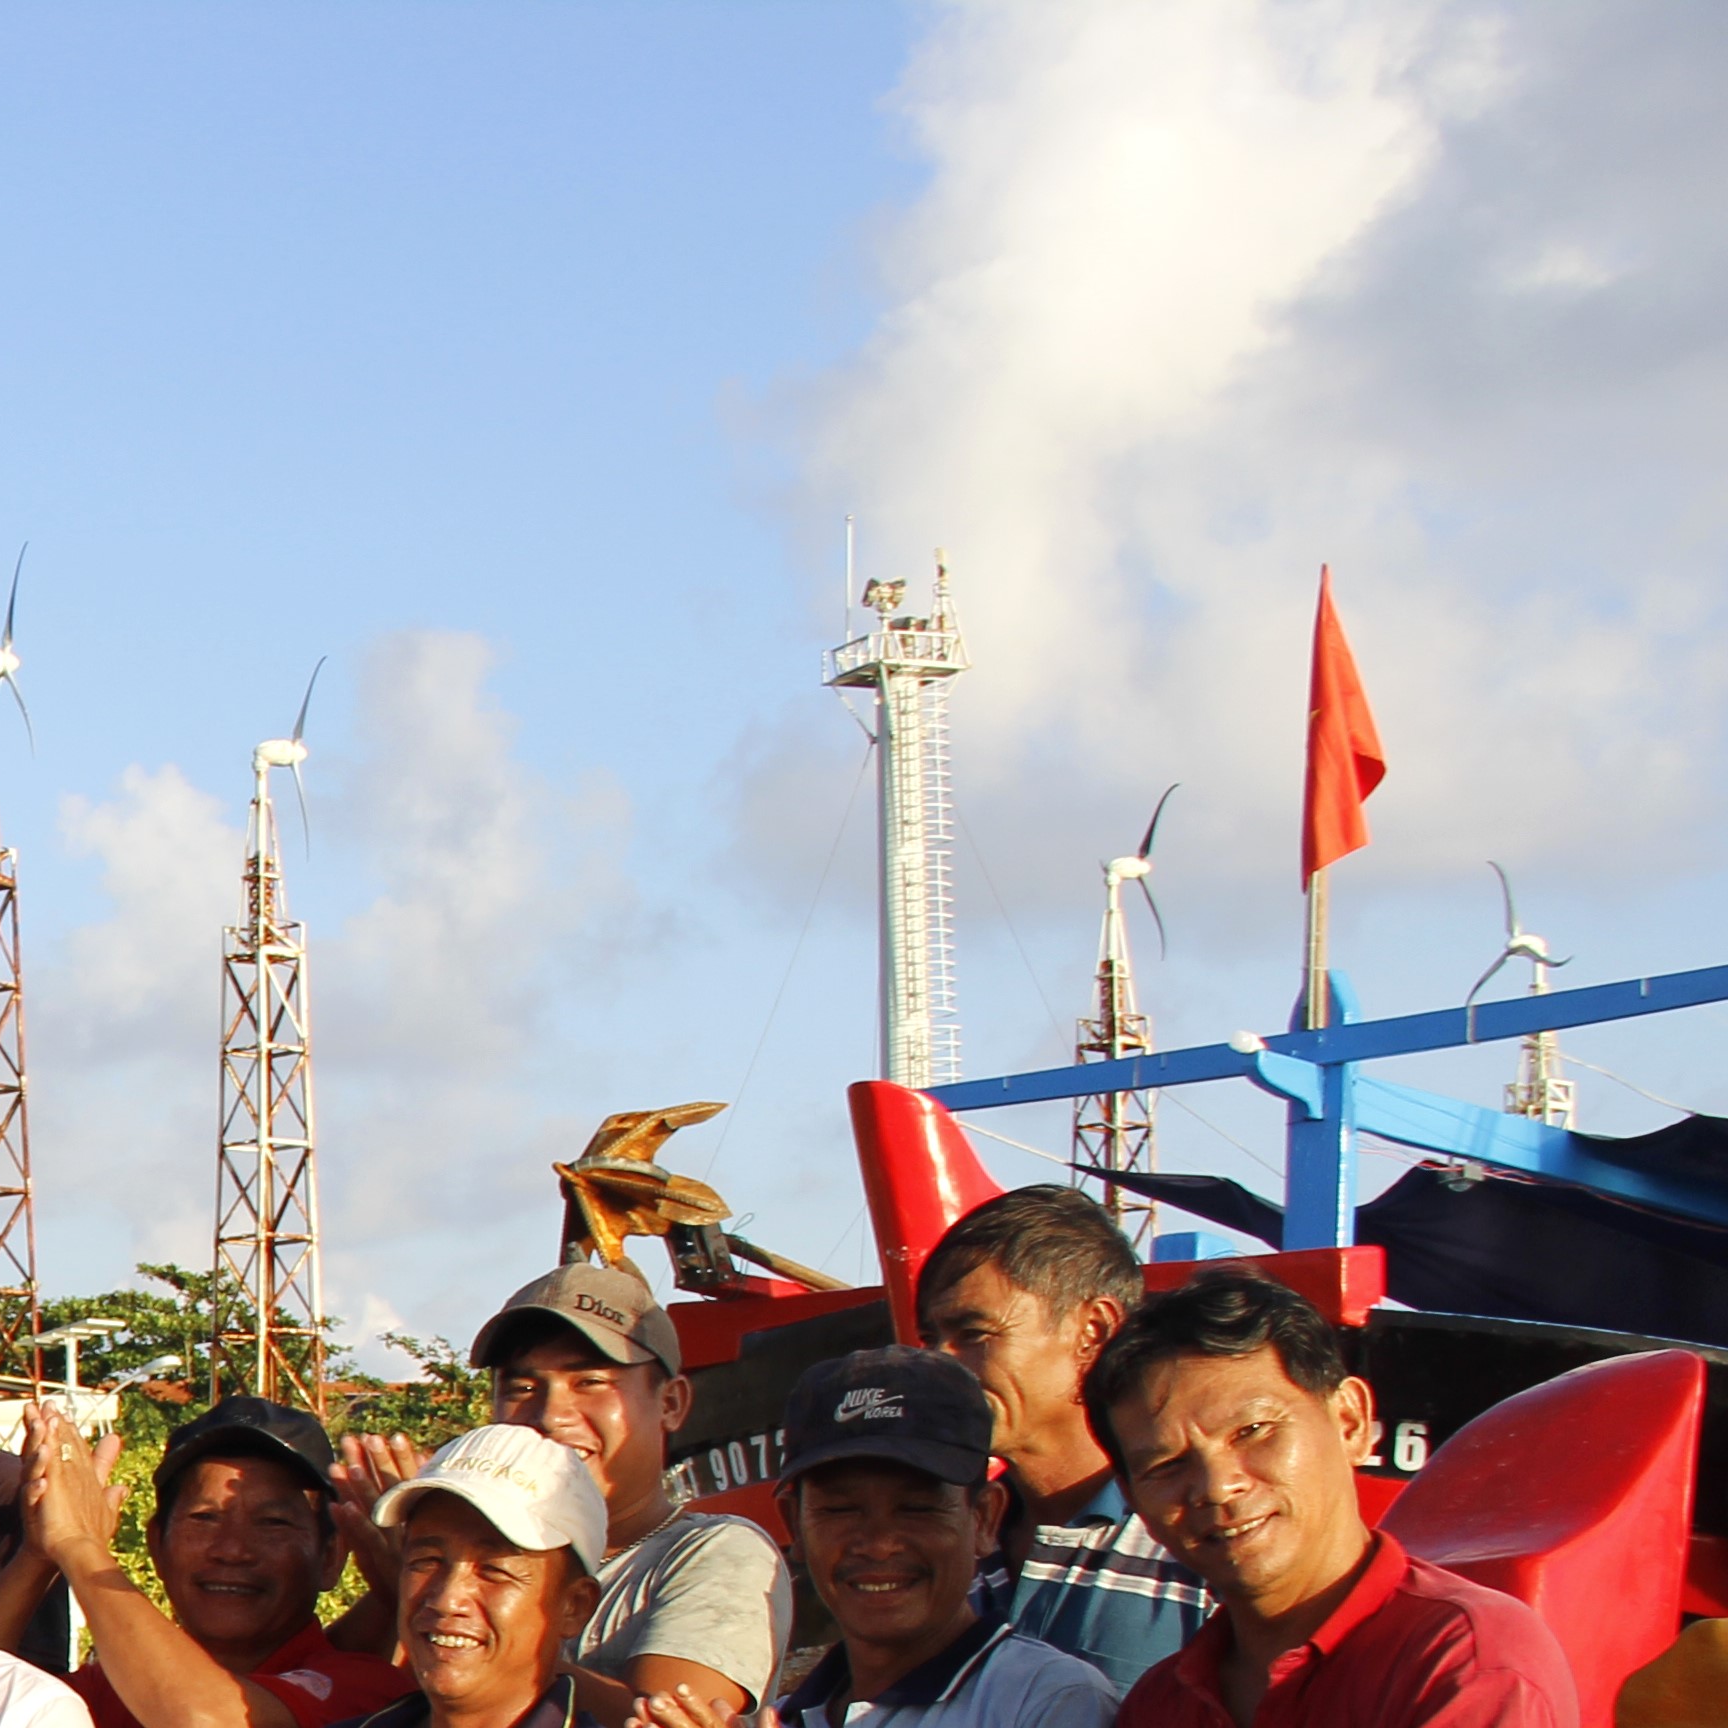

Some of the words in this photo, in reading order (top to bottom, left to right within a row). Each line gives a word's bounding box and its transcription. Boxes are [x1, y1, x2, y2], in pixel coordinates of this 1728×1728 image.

[574, 1294, 625, 1326] Dior
[843, 1388, 885, 1408] NIKE
[864, 1406, 904, 1420] KOREA
